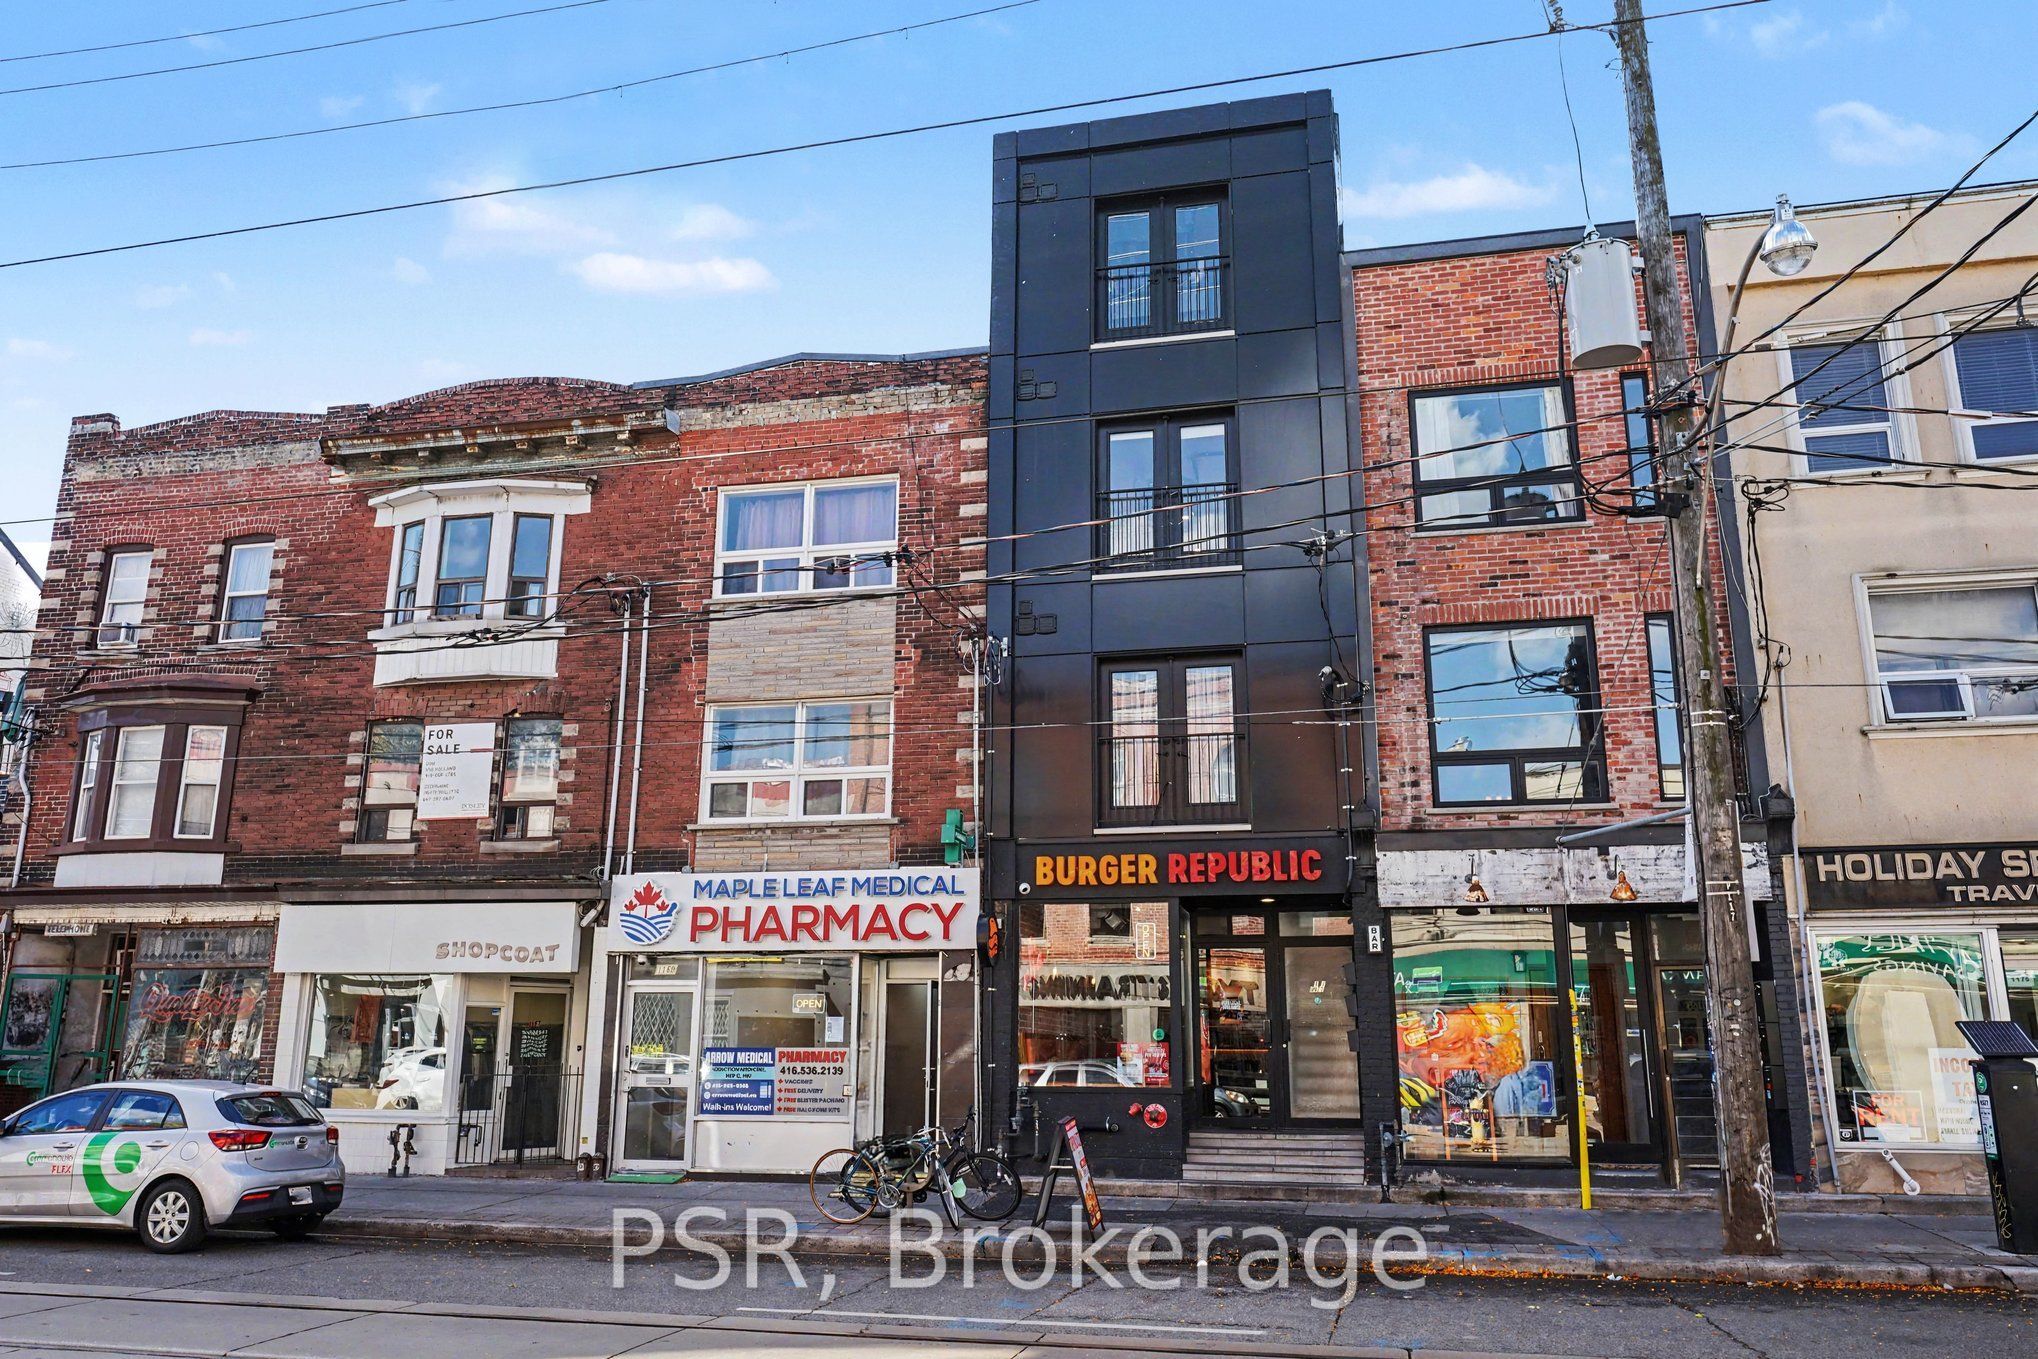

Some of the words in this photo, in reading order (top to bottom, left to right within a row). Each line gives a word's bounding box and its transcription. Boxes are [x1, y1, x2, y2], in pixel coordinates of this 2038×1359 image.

[428, 729, 454, 740] FOR
[427, 744, 461, 755] SALE
[1035, 853, 1159, 886] BURGER
[1168, 850, 1322, 883] REPUBLIC
[1816, 851, 1986, 882] HOLIDAY
[693, 879, 778, 899] MAPLE
[783, 878, 845, 897] LEAF
[851, 875, 965, 896] MEDICAL
[690, 902, 965, 942] PHARMACY
[1142, 925, 1150, 958] OPEN
[1370, 927, 1379, 950] BAR
[435, 941, 560, 963] SHOPCOAT
[796, 999, 822, 1008] OPEN
[705, 1051, 735, 1064] ARROW
[736, 1051, 773, 1064] MEDICAL
[778, 1050, 847, 1063] PHARMACY
[780, 1066, 844, 1075] 416.536.2139
[1871, 1094, 1905, 1106] FOR
